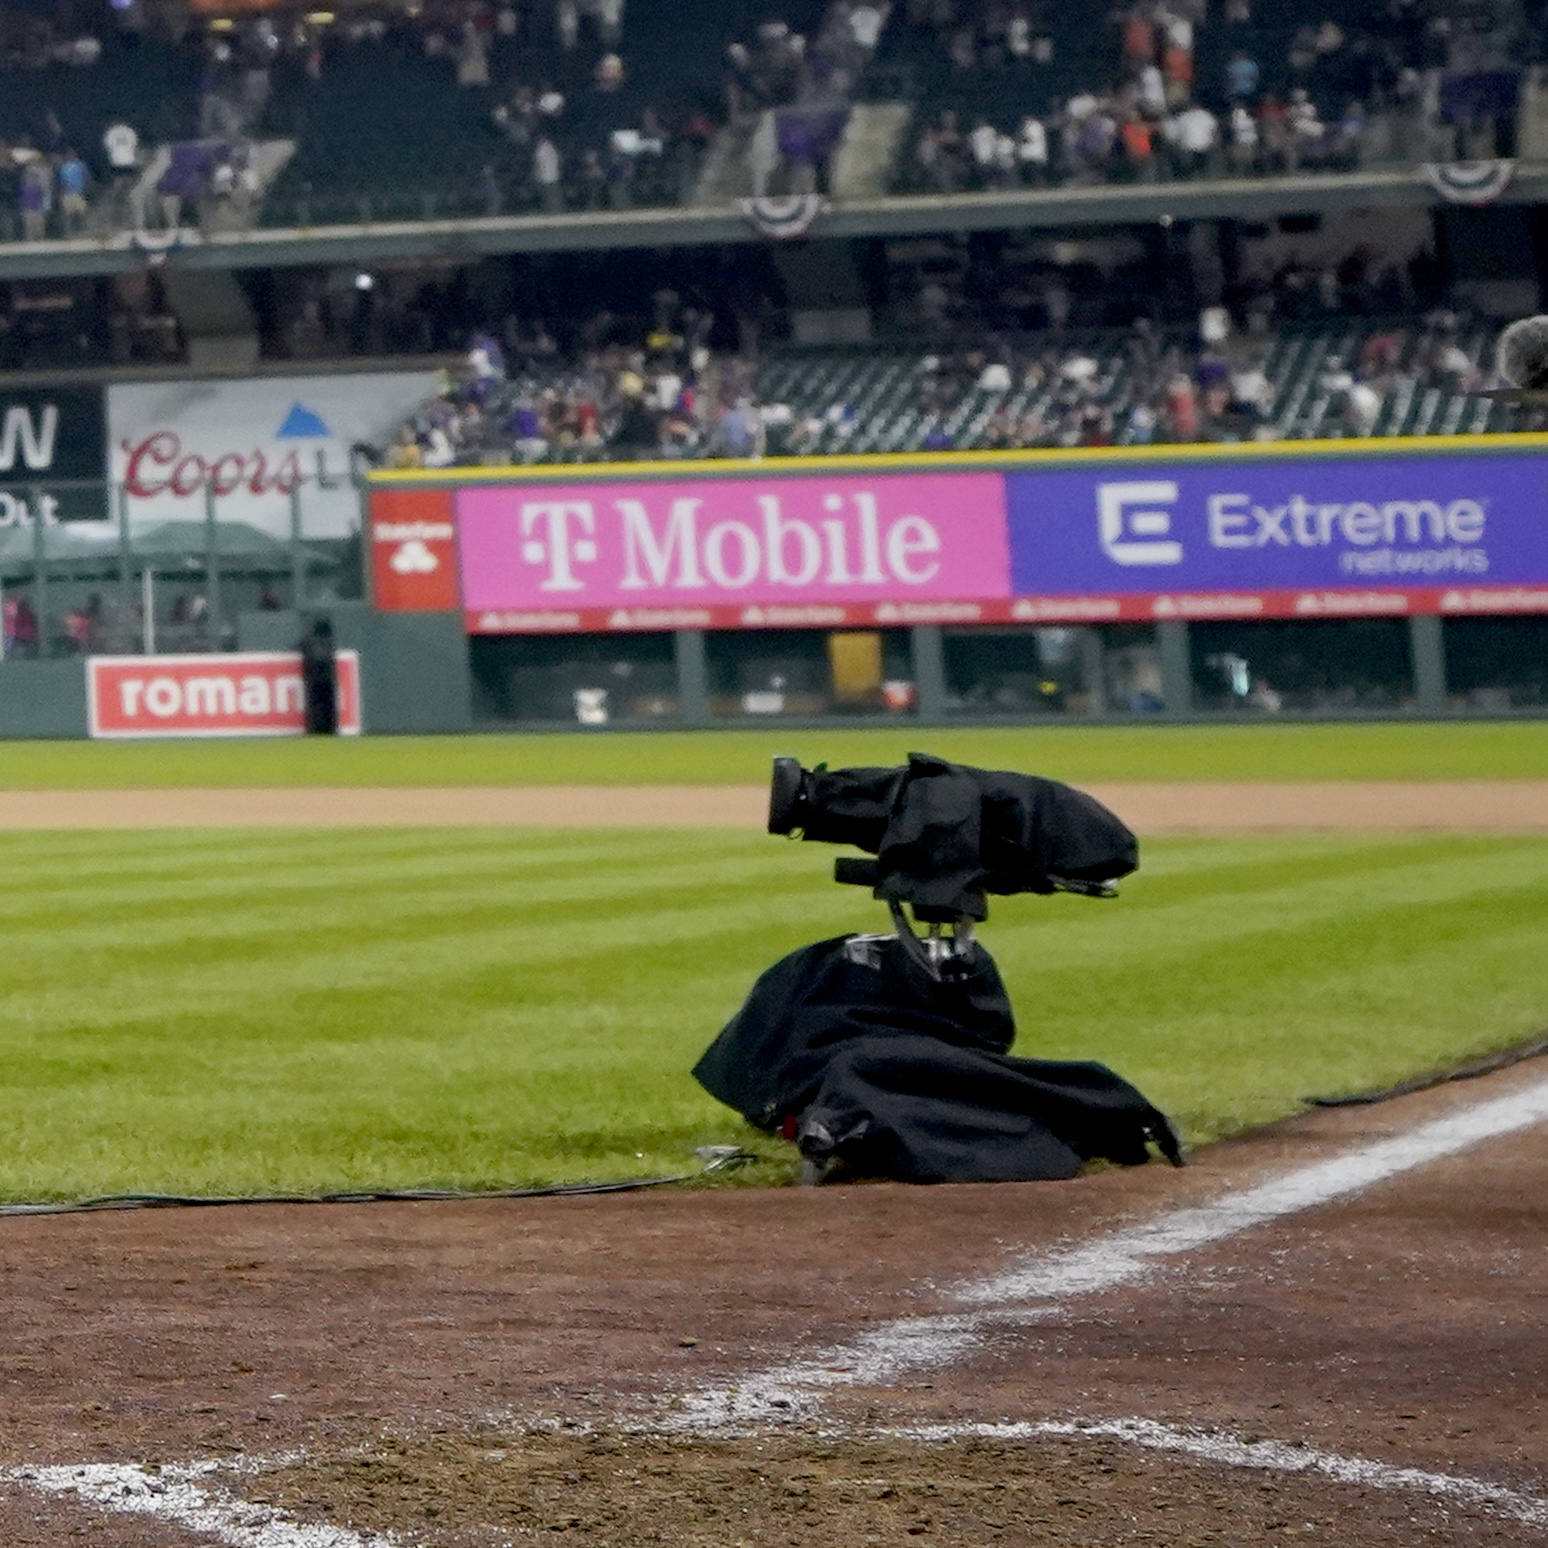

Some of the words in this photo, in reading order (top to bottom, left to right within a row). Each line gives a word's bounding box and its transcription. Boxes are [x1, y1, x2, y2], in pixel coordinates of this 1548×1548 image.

[121, 430, 301, 499] Coors
[614, 492, 942, 590] Mobile
[1207, 493, 1487, 548] Extreme
[1339, 548, 1490, 574] networks
[120, 673, 307, 717] roman
